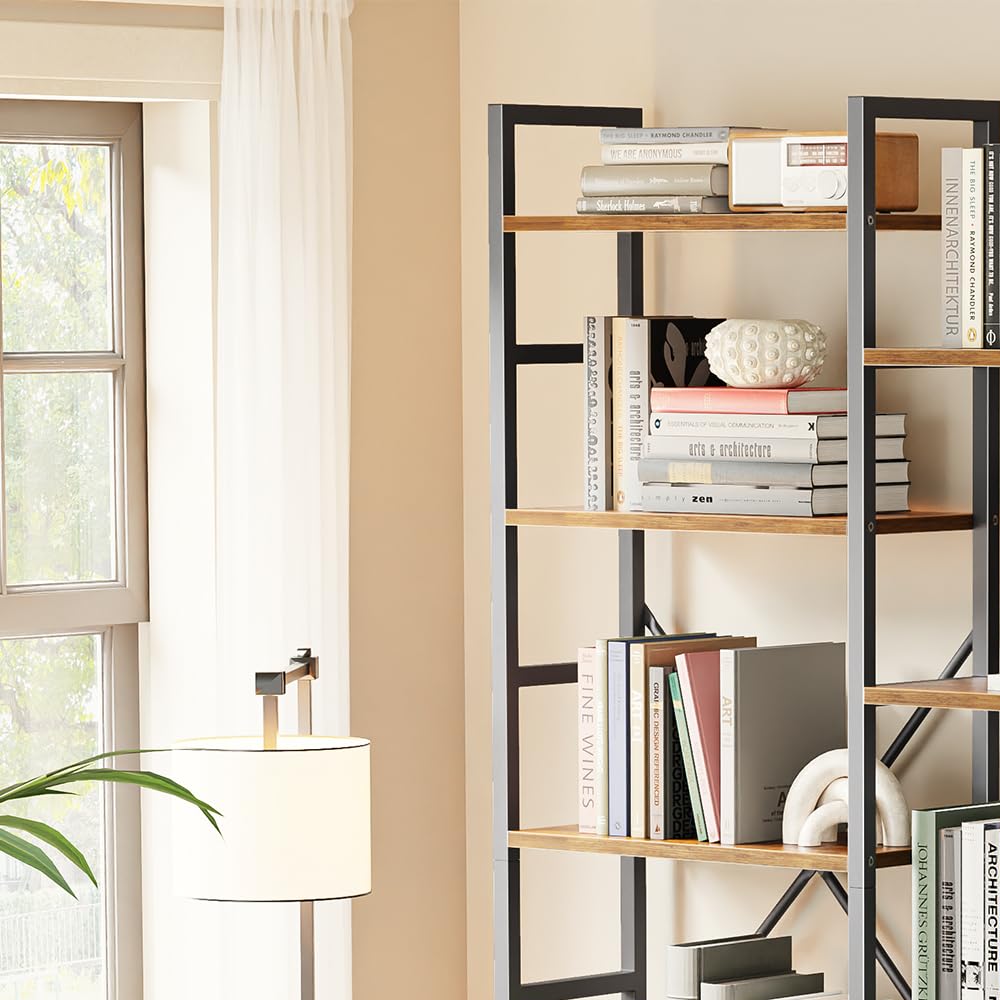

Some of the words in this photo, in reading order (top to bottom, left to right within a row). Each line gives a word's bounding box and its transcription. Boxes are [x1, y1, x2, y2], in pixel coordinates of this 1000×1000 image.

[610, 149, 622, 160] WE
[623, 149, 637, 160] ARE
[638, 149, 683, 160] ANONYMOUS
[596, 199, 621, 211] Sherlock
[624, 199, 645, 211] Holmes
[945, 178, 959, 336] INNENARCHITEKTUR
[629, 371, 643, 389] arts
[629, 393, 643, 401] &
[629, 404, 643, 461] architecture
[688, 442, 706, 457] arts
[710, 443, 716, 456] &
[719, 441, 772, 458] architecture
[691, 494, 713, 503] zen
[582, 674, 594, 724] FINE
[722, 696, 732, 726] ART
[582, 735, 594, 808] WINES
[917, 842, 928, 928] JOHANNES
[942, 881, 955, 900] arts
[988, 842, 998, 973] ARCHITECTURE
[942, 915, 955, 973] architecture
